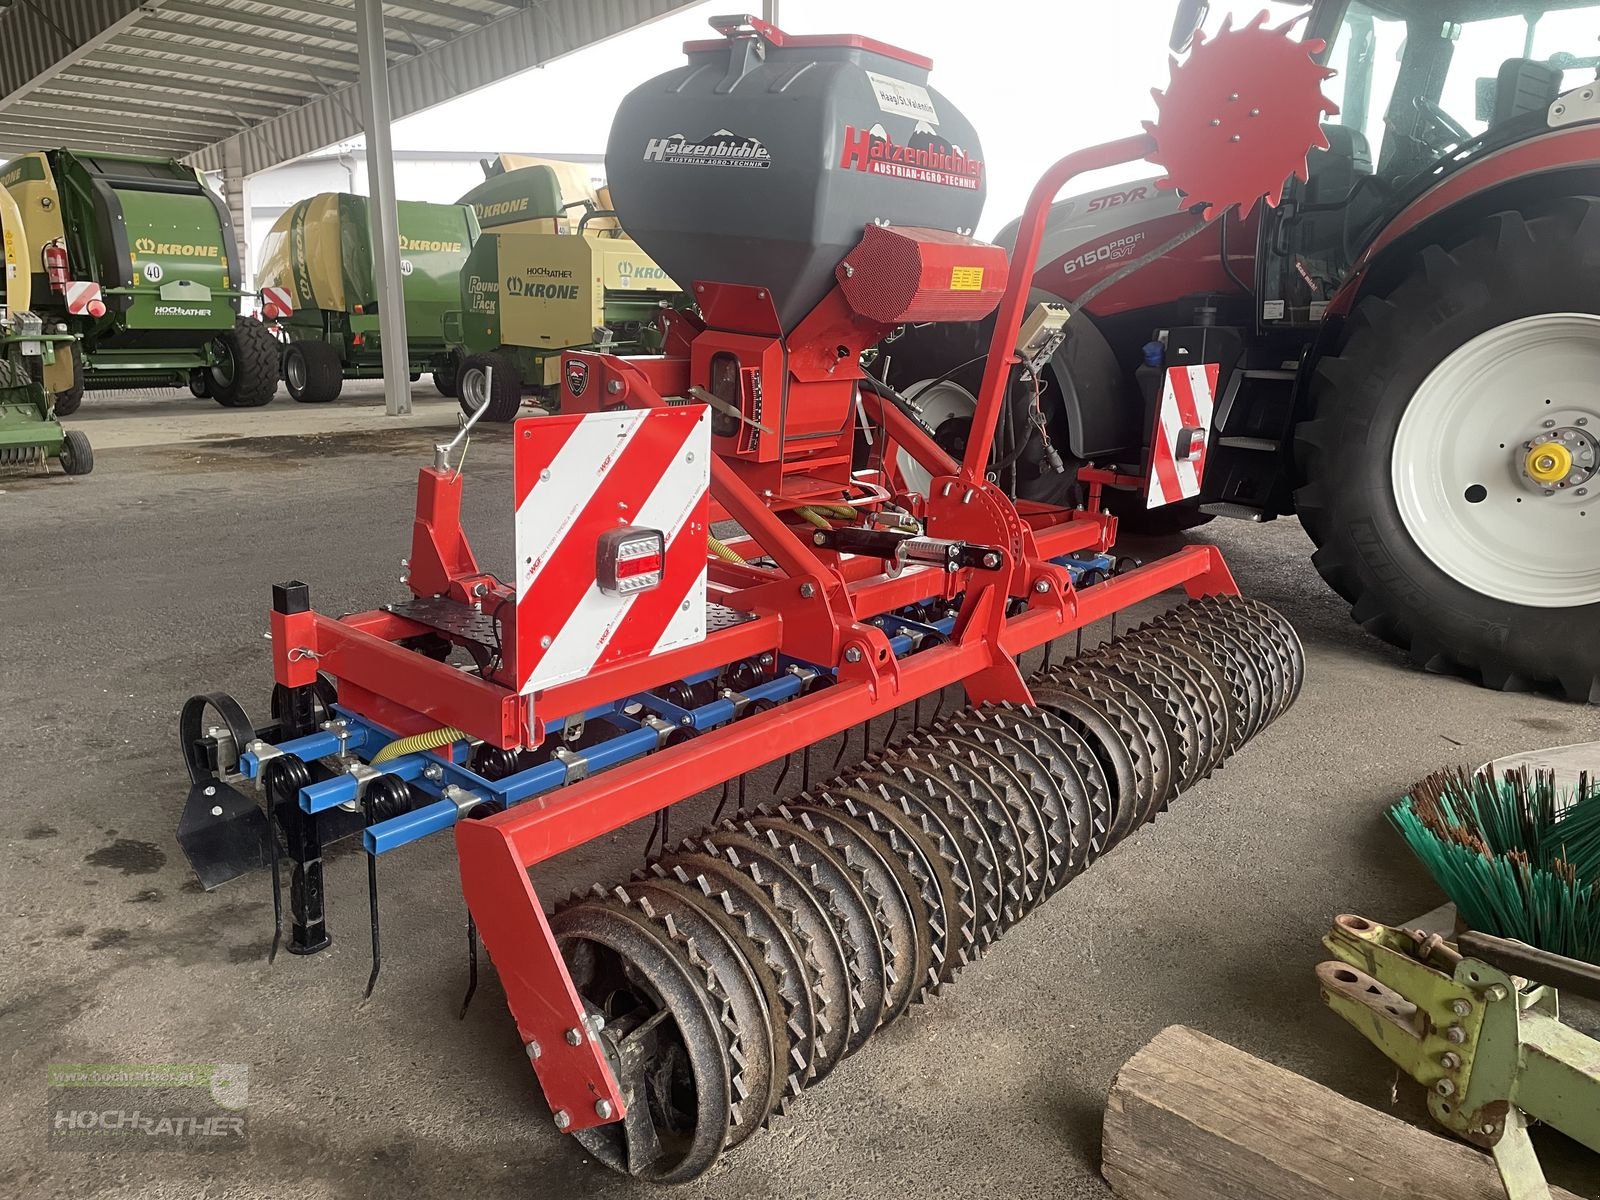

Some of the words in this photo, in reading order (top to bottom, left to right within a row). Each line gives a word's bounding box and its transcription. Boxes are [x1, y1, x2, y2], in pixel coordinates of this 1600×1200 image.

[643, 138, 770, 161] Hatzenbichle
[841, 125, 983, 176] Hatzenbichler
[484, 198, 529, 218] KRONE
[1087, 187, 1148, 213] STEYR
[157, 244, 218, 256] KRONE
[409, 240, 461, 252] KRONE
[1064, 245, 1110, 274] 6150
[1110, 232, 1145, 250] PROFI
[1111, 243, 1136, 260] CVT
[147, 266, 160, 279] 40
[527, 267, 572, 278] HOCHRATHER
[635, 267, 669, 279] KRO
[524, 283, 579, 300] KRONE
[155, 306, 211, 316] HOCHRATHER
[528, 557, 542, 574] WGF
